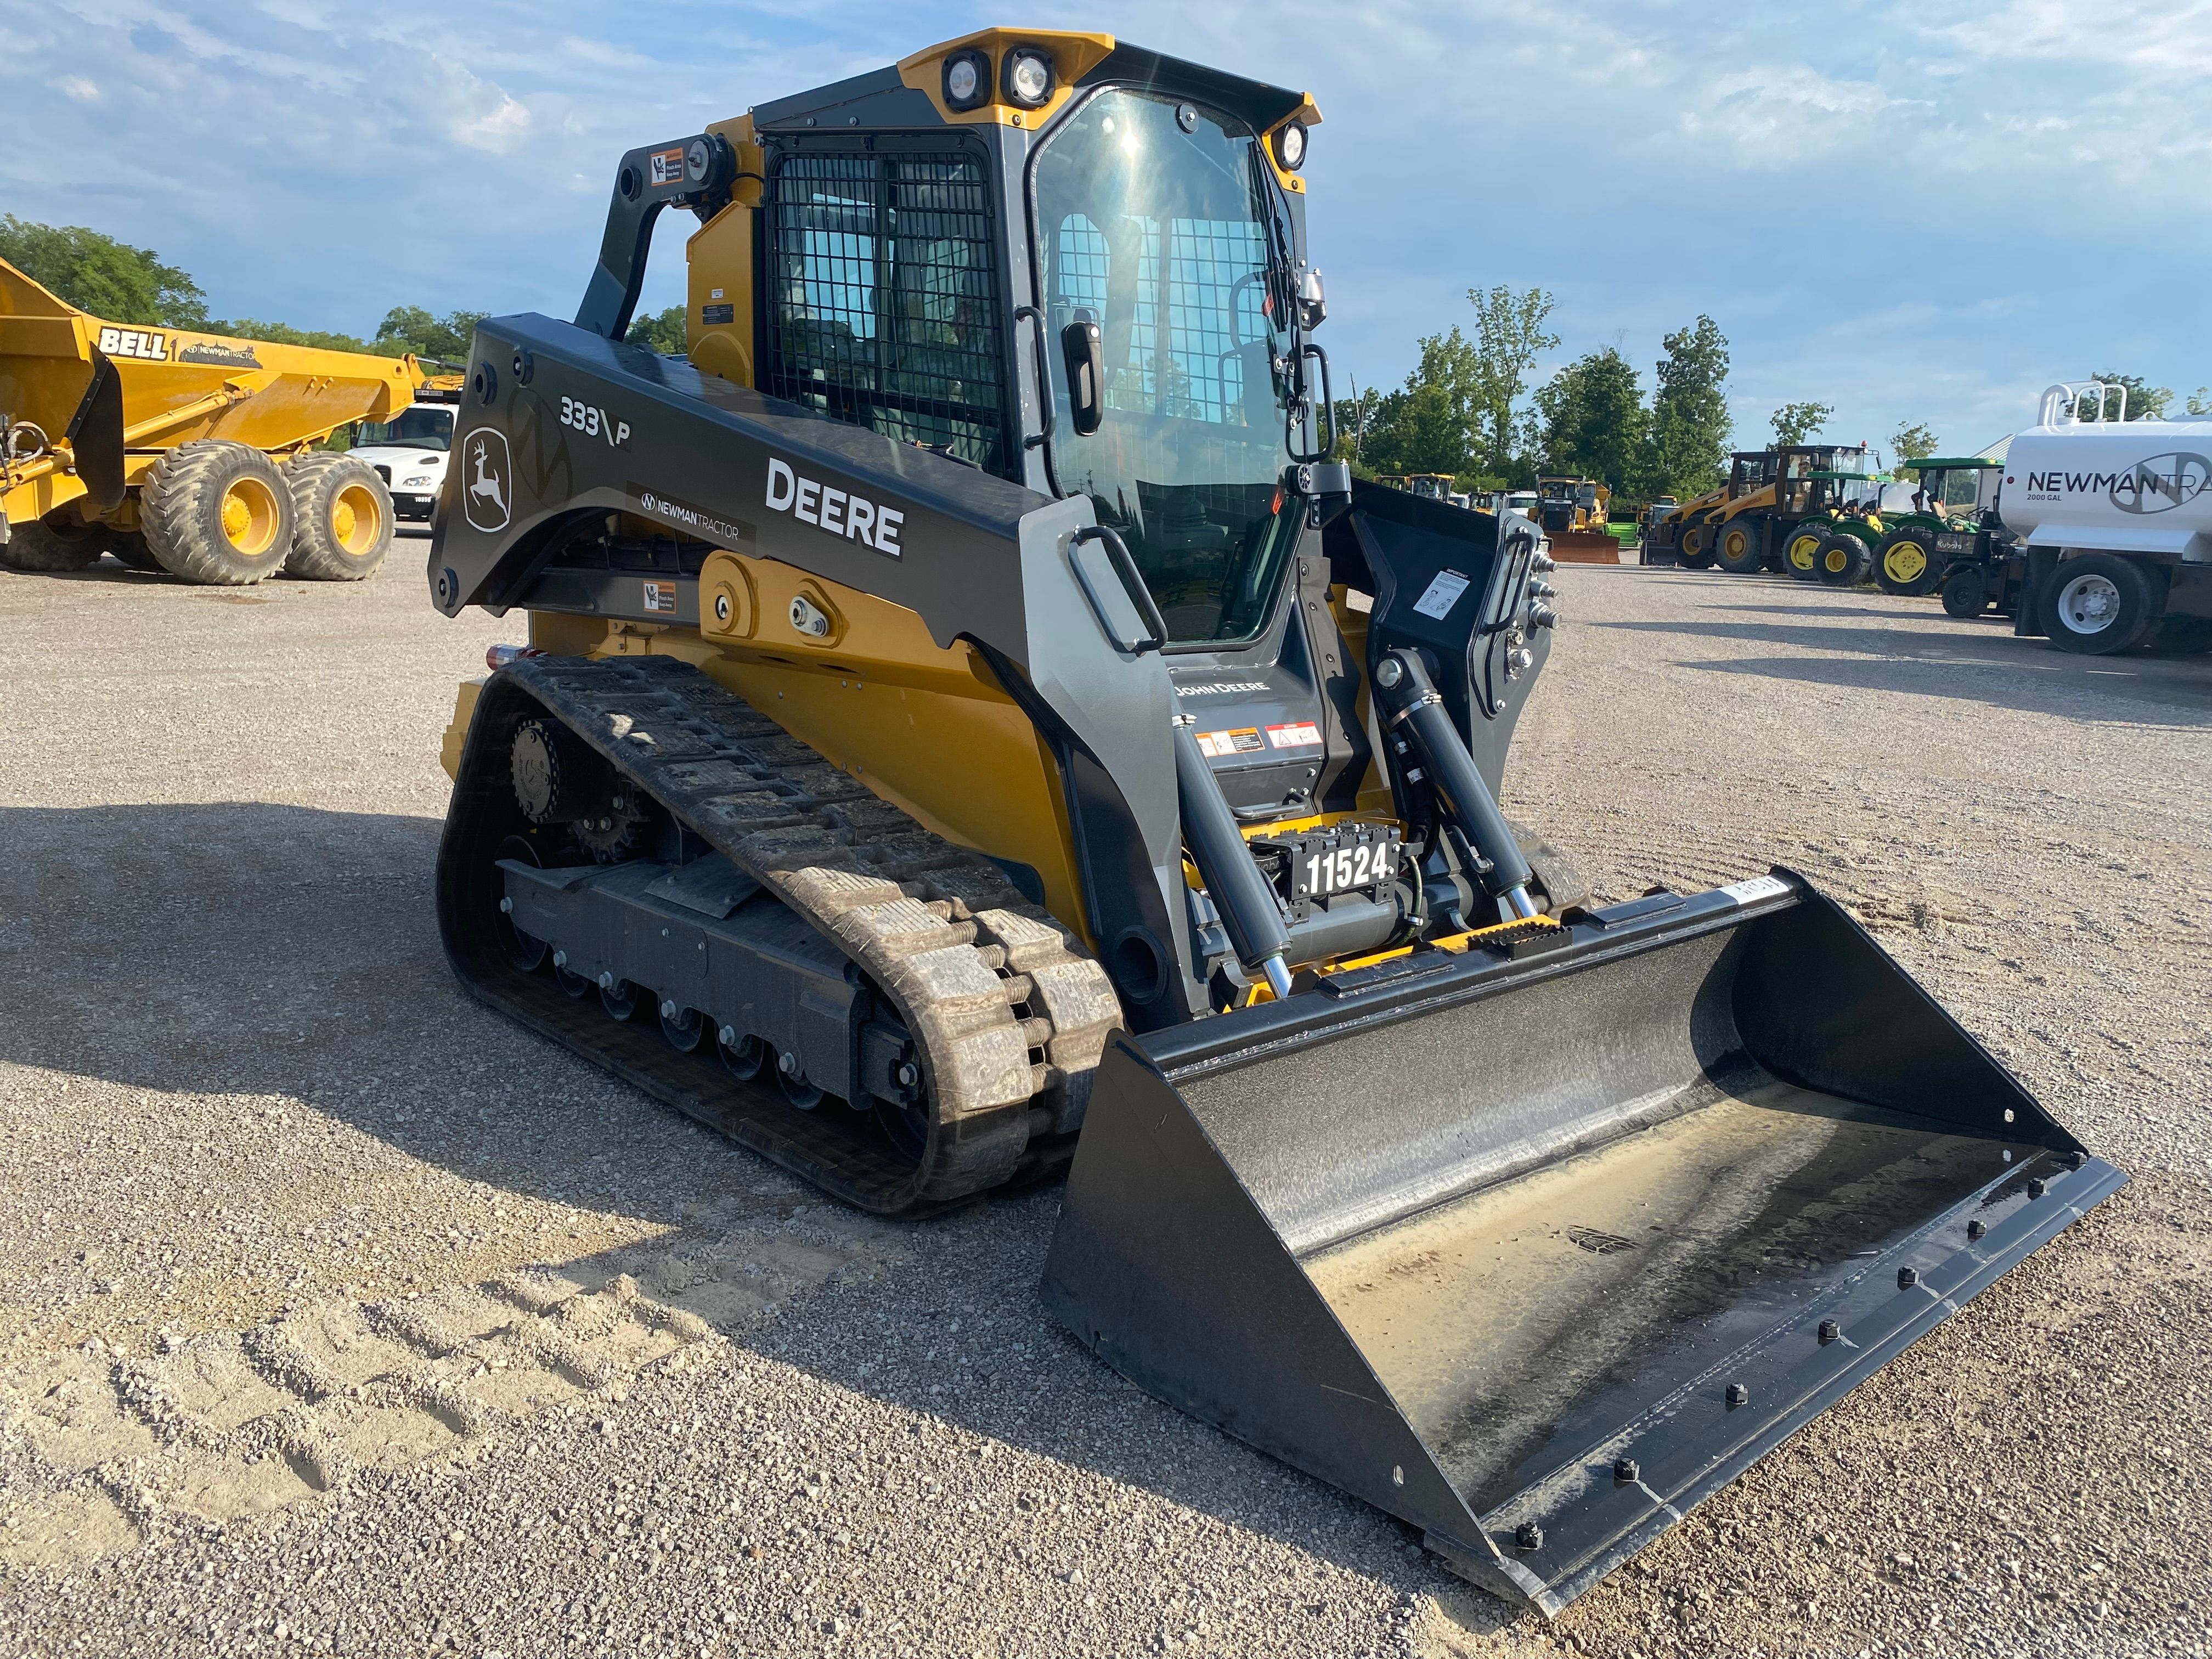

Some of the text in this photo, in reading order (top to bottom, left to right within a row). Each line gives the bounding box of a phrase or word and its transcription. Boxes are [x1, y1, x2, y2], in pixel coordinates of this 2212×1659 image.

[98, 328, 167, 360] BELL
[658, 499, 739, 541] NEWMANTRACTOR
[765, 457, 905, 556] DEERE
[1937, 540, 1962, 550] Kubota
[1446, 568, 1469, 579] IMPORTANT
[1173, 682, 1271, 696] JOHN DEERE
[1307, 842, 1387, 894] 11524
